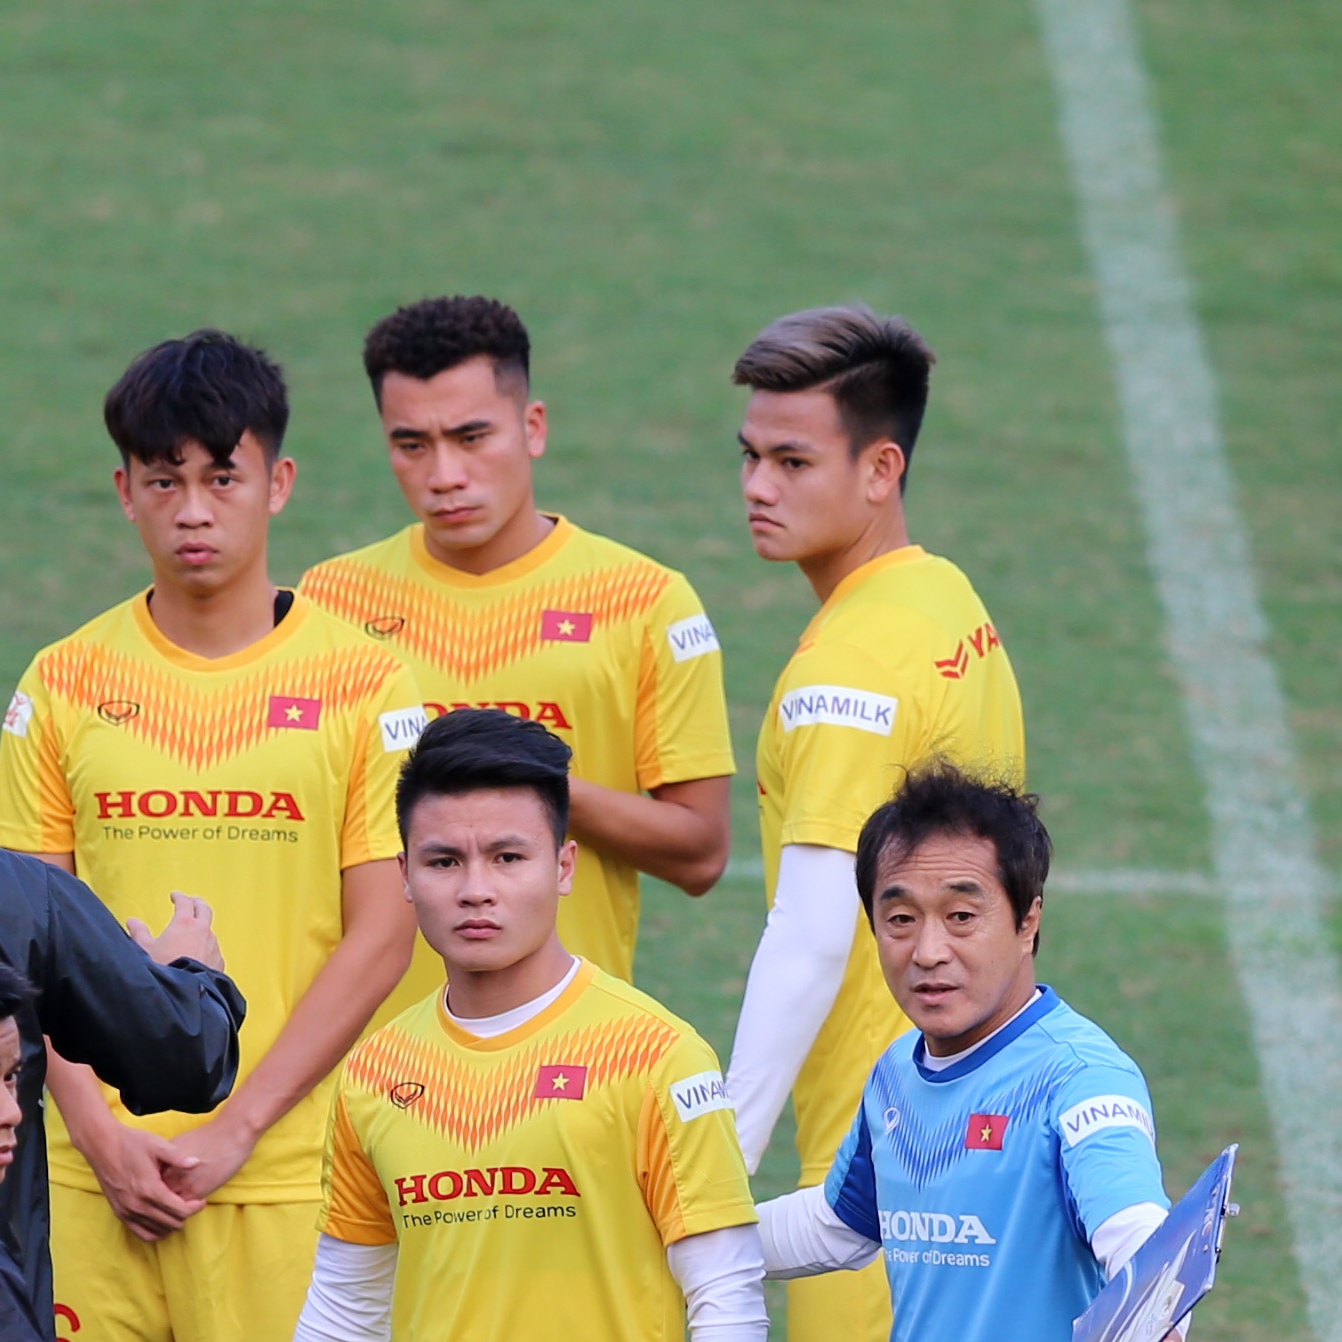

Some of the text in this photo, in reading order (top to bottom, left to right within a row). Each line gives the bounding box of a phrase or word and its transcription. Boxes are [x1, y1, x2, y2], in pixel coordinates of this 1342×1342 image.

[782, 694, 891, 727] VINAMILK
[94, 790, 305, 821] HONDA
[103, 825, 299, 843] The Power of Dreams
[394, 1166, 581, 1207] HONDA
[403, 1213, 432, 1229] The
[434, 1209, 483, 1225] Power
[504, 1204, 577, 1220] Dreams
[878, 1210, 997, 1244] HONDA
[932, 1250, 991, 1267] Dreams
